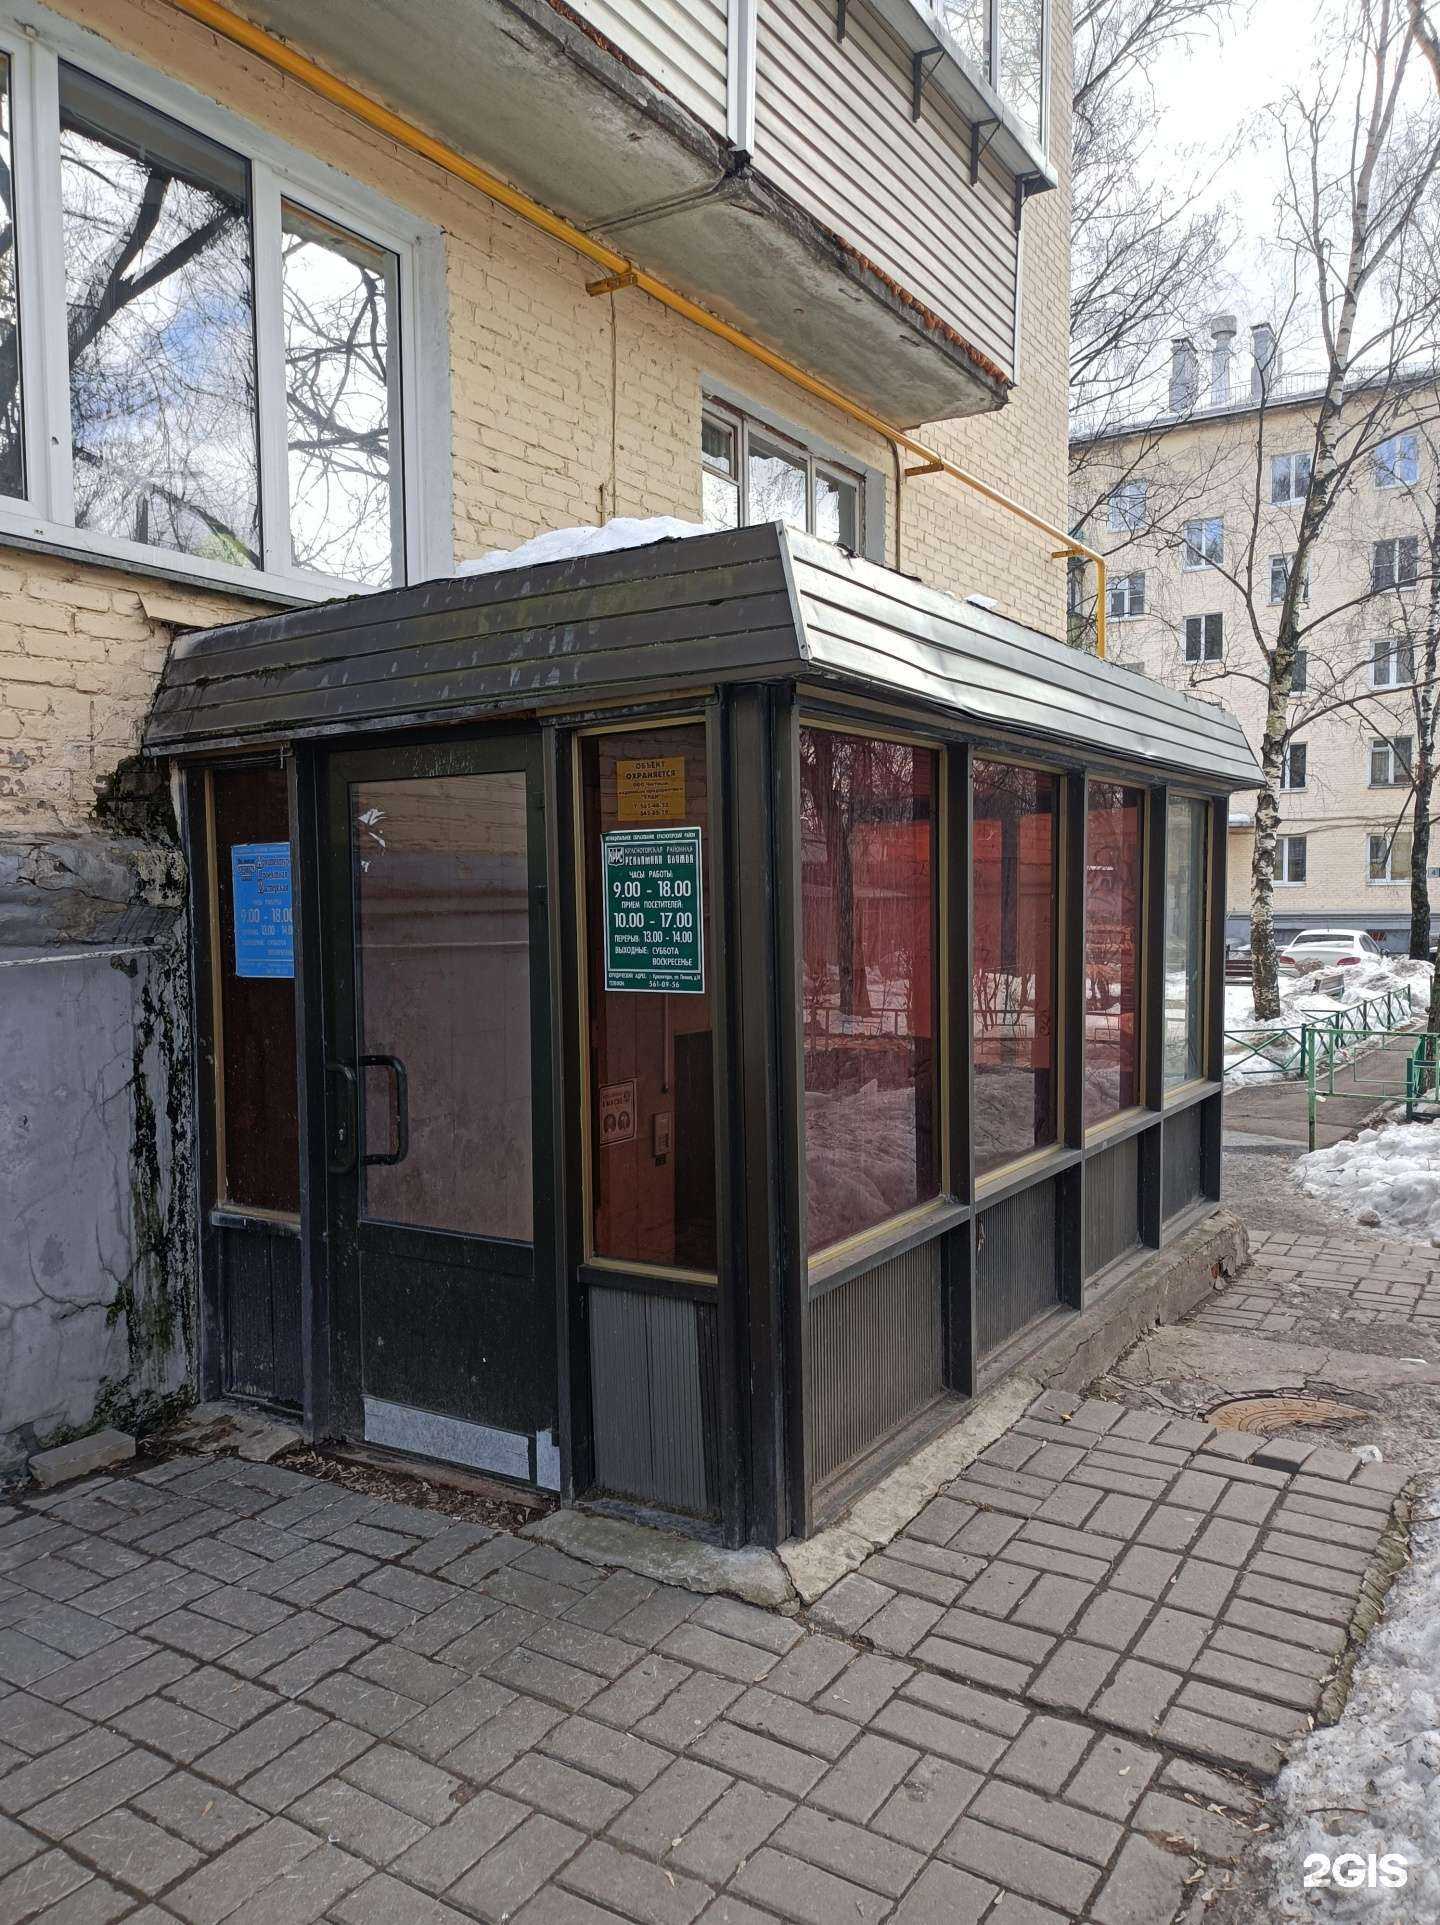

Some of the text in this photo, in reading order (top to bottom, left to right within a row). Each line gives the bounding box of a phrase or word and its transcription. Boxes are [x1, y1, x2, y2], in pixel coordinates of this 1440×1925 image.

[626, 770, 675, 779] ОХРАНЯЕТСЯ
[628, 870, 645, 878] ЧАСЫ
[613, 882, 641, 898] 9.00
[657, 880, 692, 897] 18.00
[614, 912, 645, 928] 10.00
[660, 912, 692, 928] 17.00
[643, 930, 663, 943] 13.00
[672, 930, 692, 943] 14.00
[652, 947, 680, 955] СУББОТА
[652, 958, 693, 966] ВОСКРЕСЕНЬЕ
